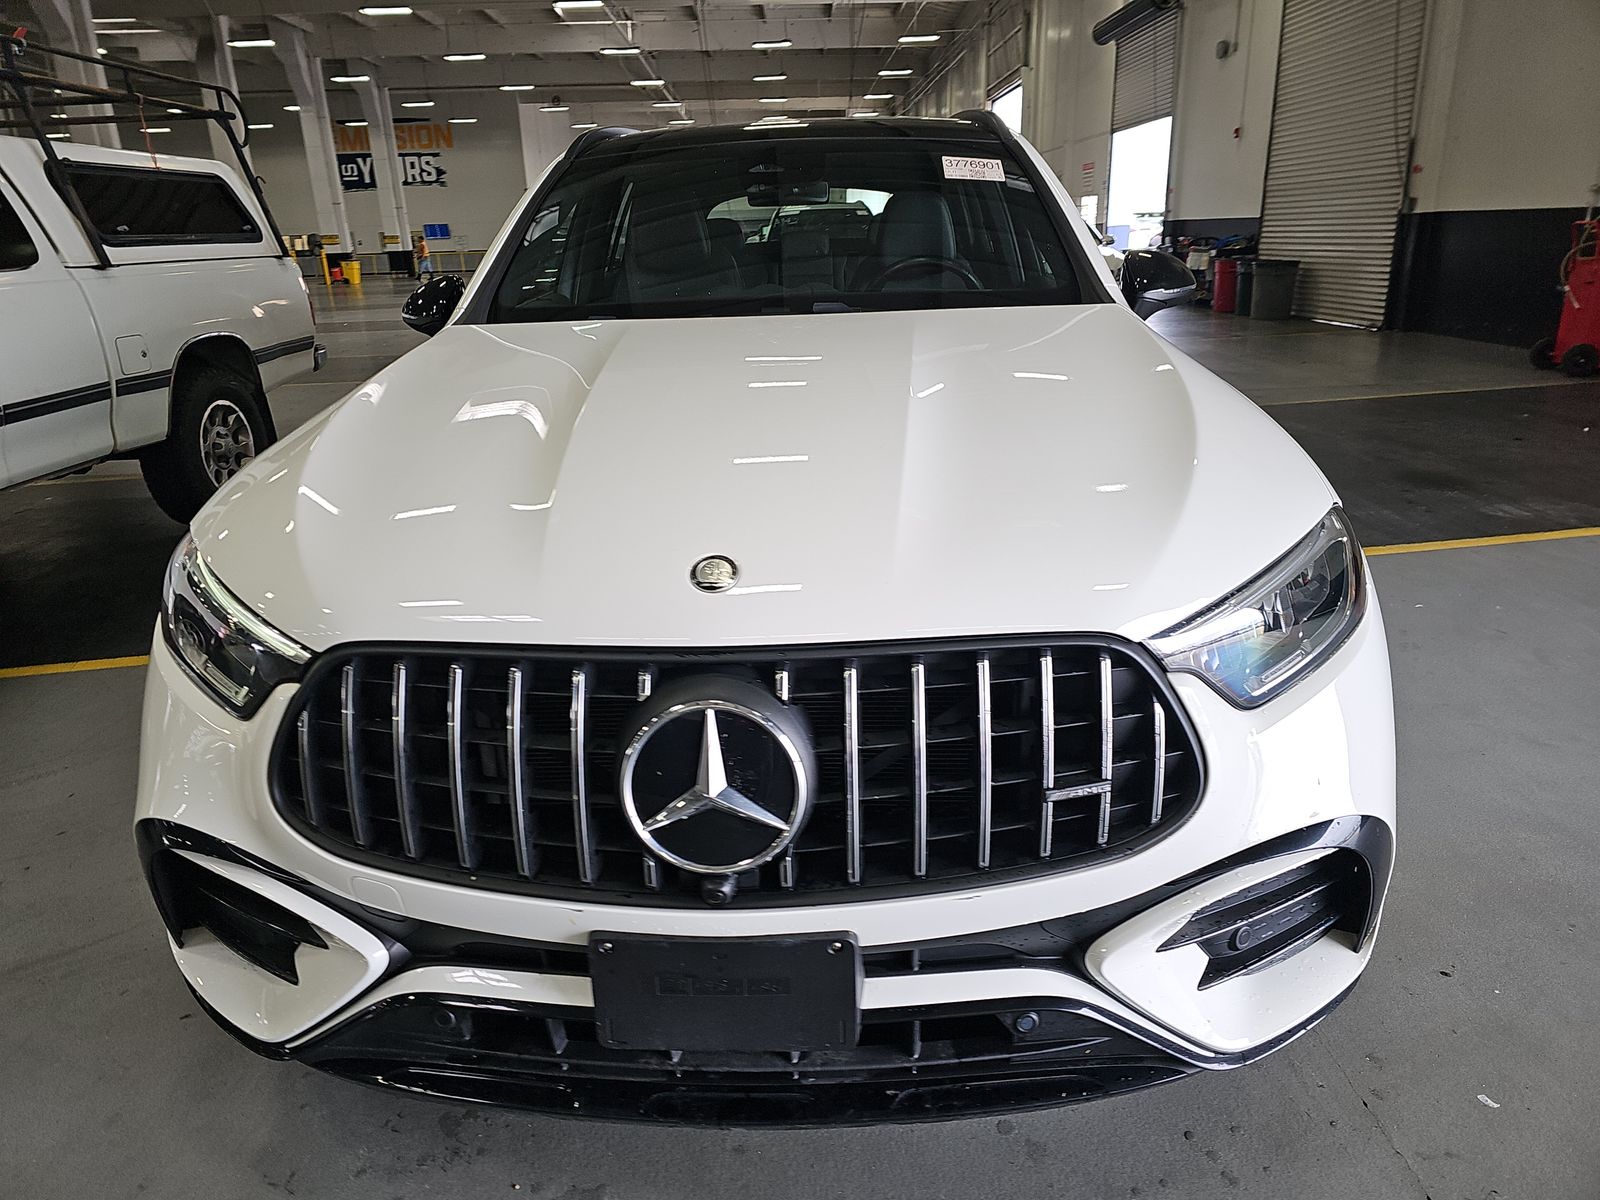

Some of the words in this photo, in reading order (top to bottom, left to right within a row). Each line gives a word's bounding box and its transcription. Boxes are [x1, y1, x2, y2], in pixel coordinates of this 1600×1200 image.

[340, 123, 453, 151] MISION
[356, 155, 437, 183] YRS
[945, 159, 1000, 170] 3776901
